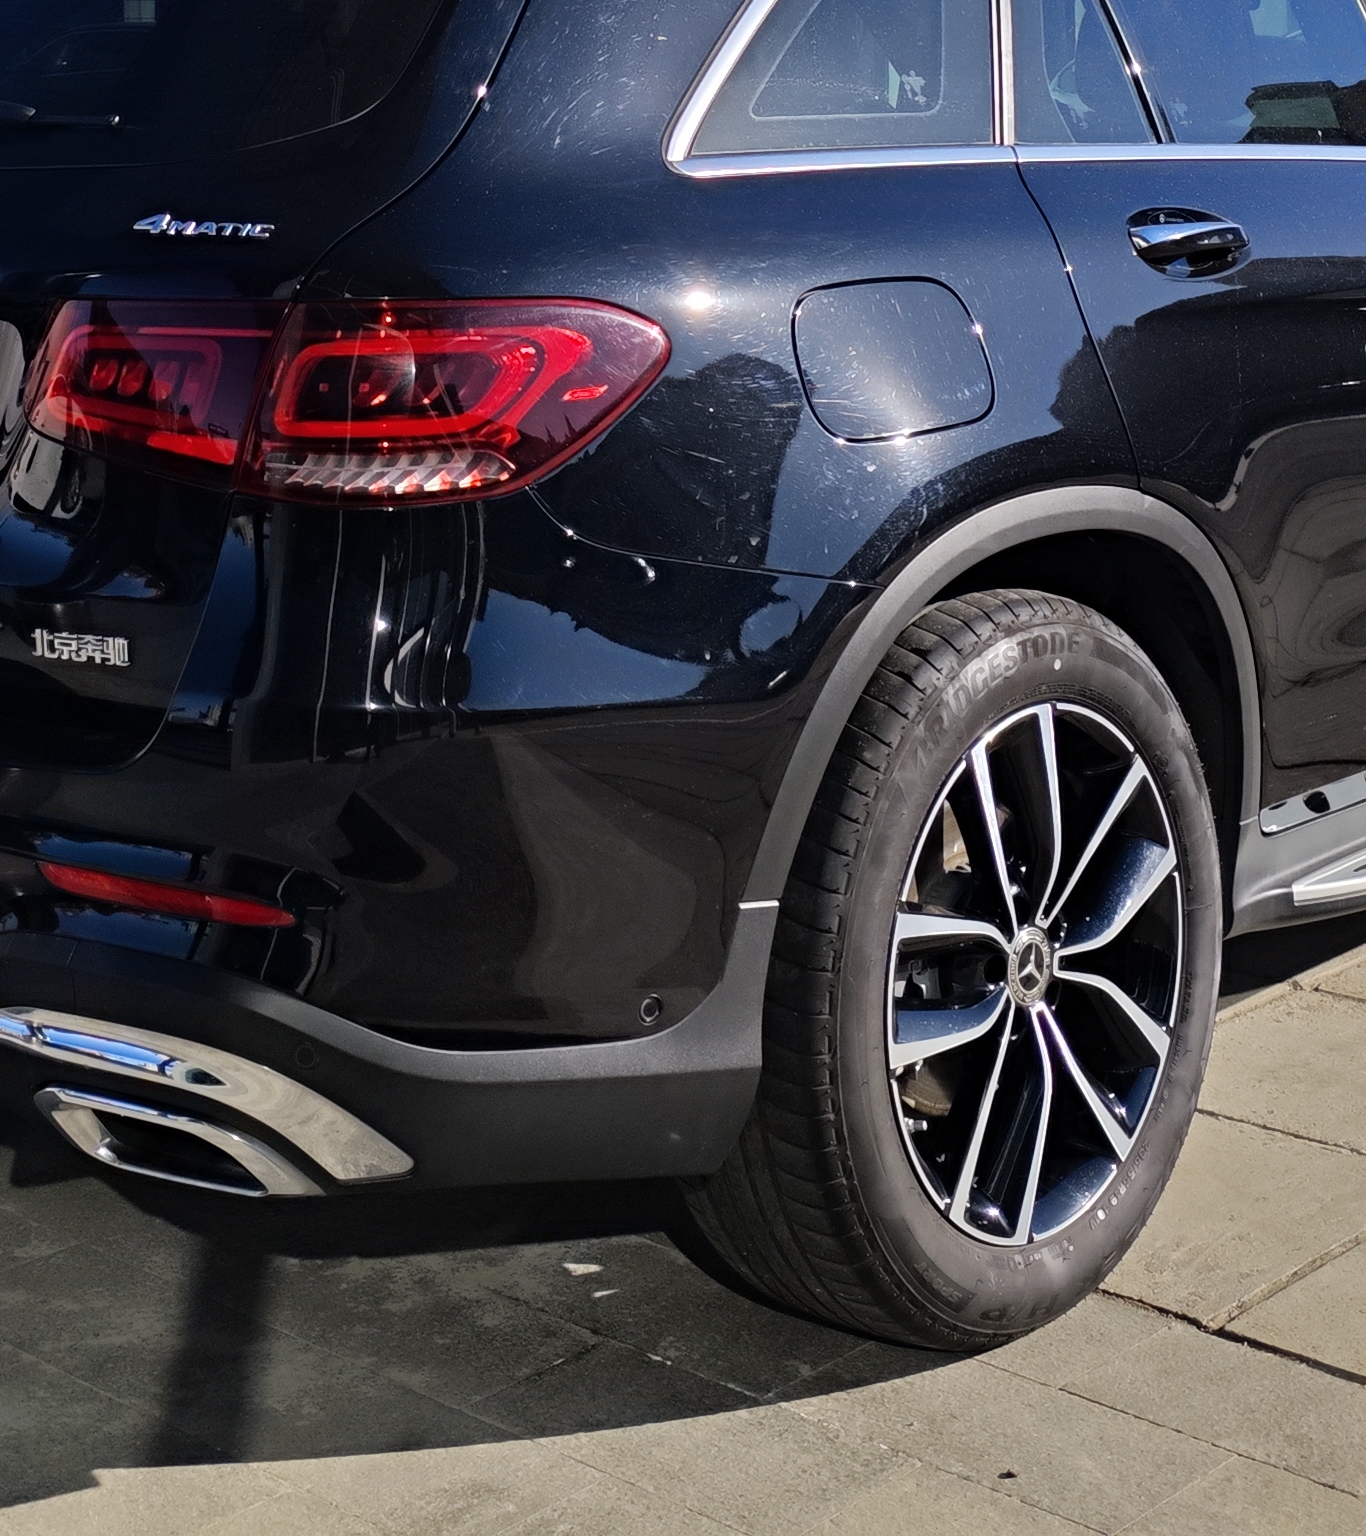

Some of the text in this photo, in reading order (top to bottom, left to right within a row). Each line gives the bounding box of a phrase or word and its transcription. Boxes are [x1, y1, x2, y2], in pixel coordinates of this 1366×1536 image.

[133, 212, 274, 239] 4MATIC
[31, 627, 131, 668] 北京奔驰
